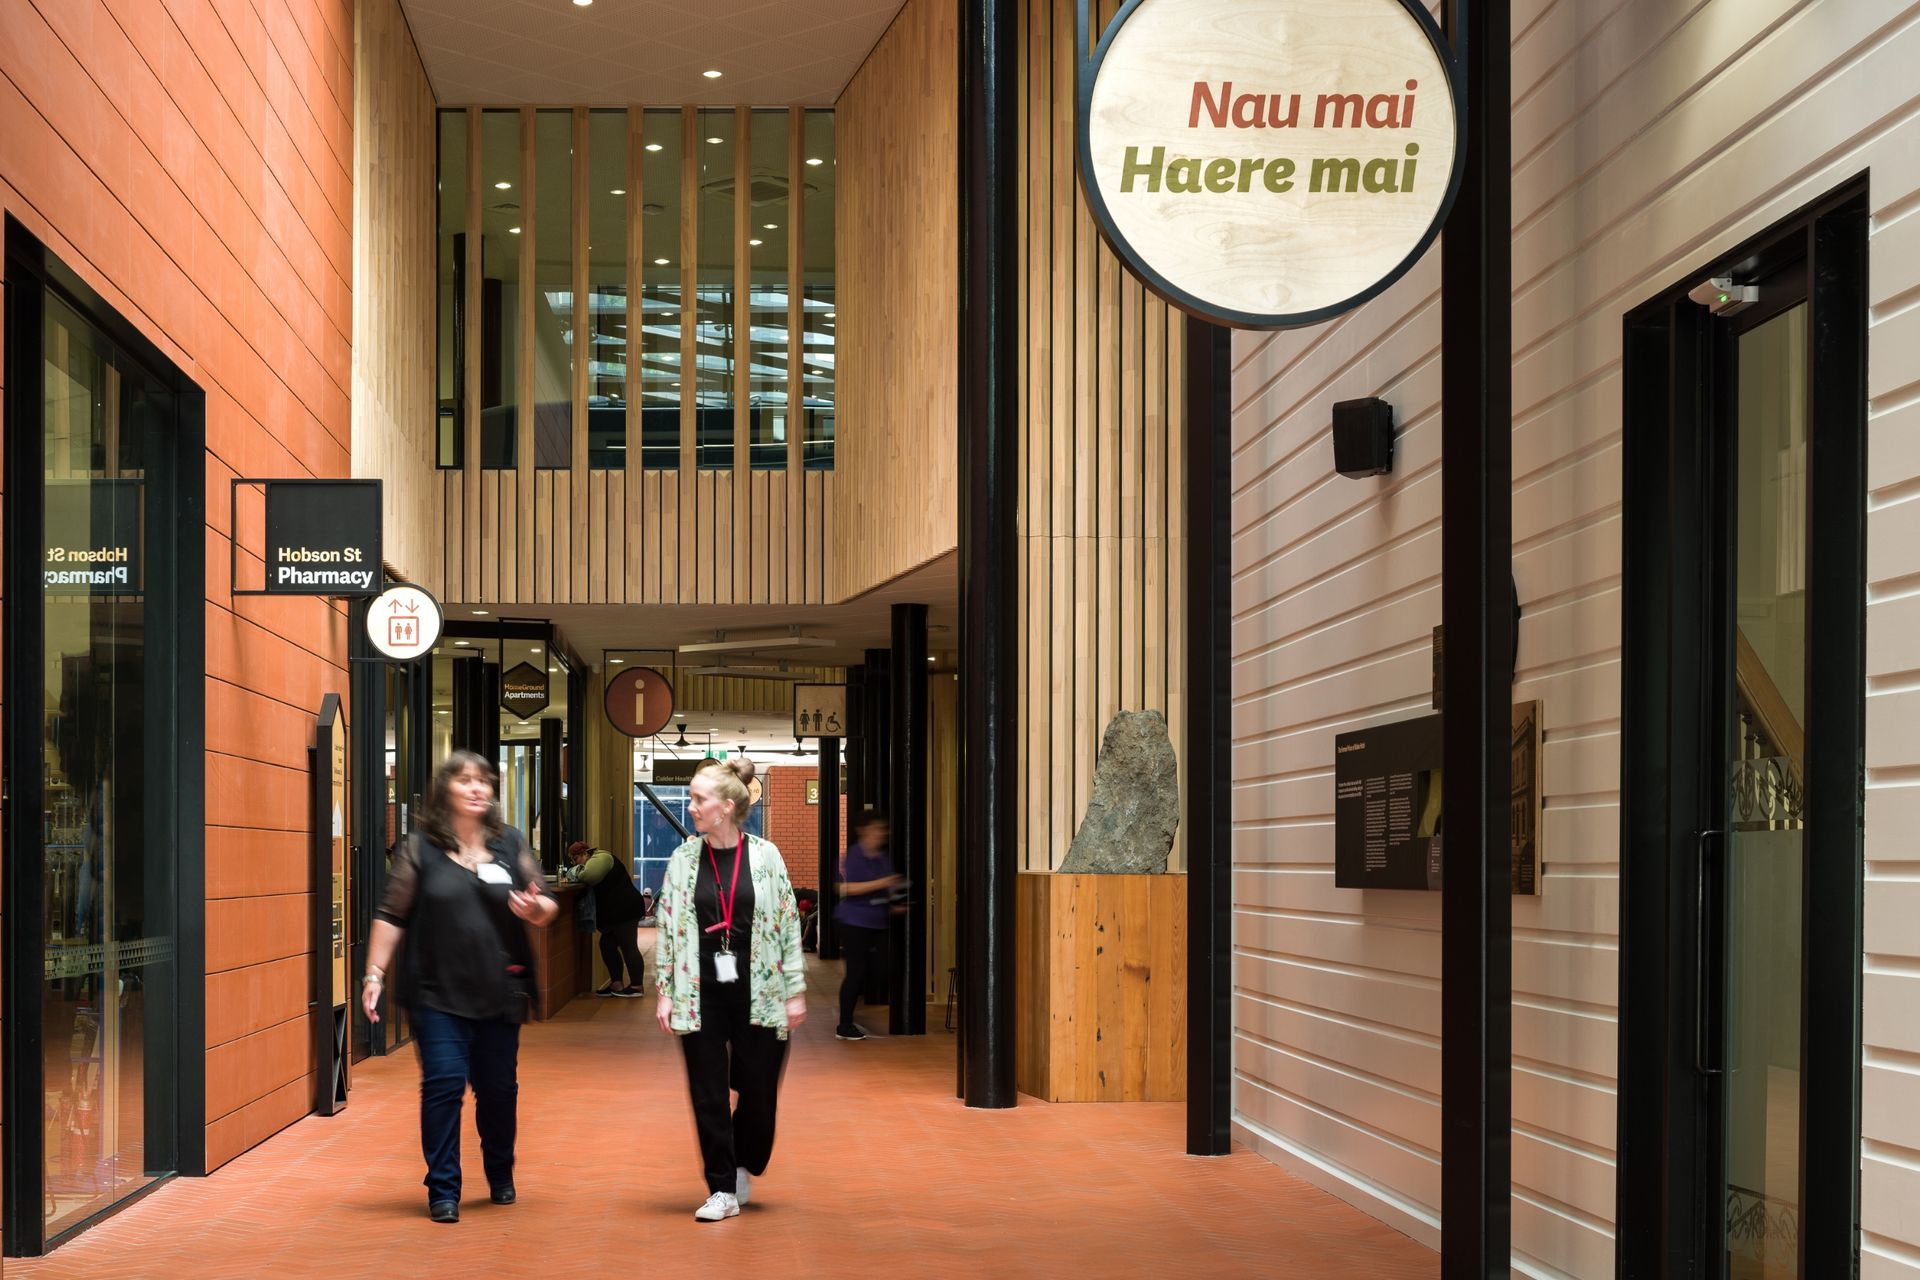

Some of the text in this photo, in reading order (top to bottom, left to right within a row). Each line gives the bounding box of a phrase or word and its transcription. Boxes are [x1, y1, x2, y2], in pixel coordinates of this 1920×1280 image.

[1188, 79, 1418, 129] Nau mai
[1120, 142, 1420, 194] Haere mai
[278, 547, 363, 562] Hobson St
[278, 566, 374, 589] Pharmacy
[504, 691, 545, 700] Apartments
[810, 788, 818, 799] 3
